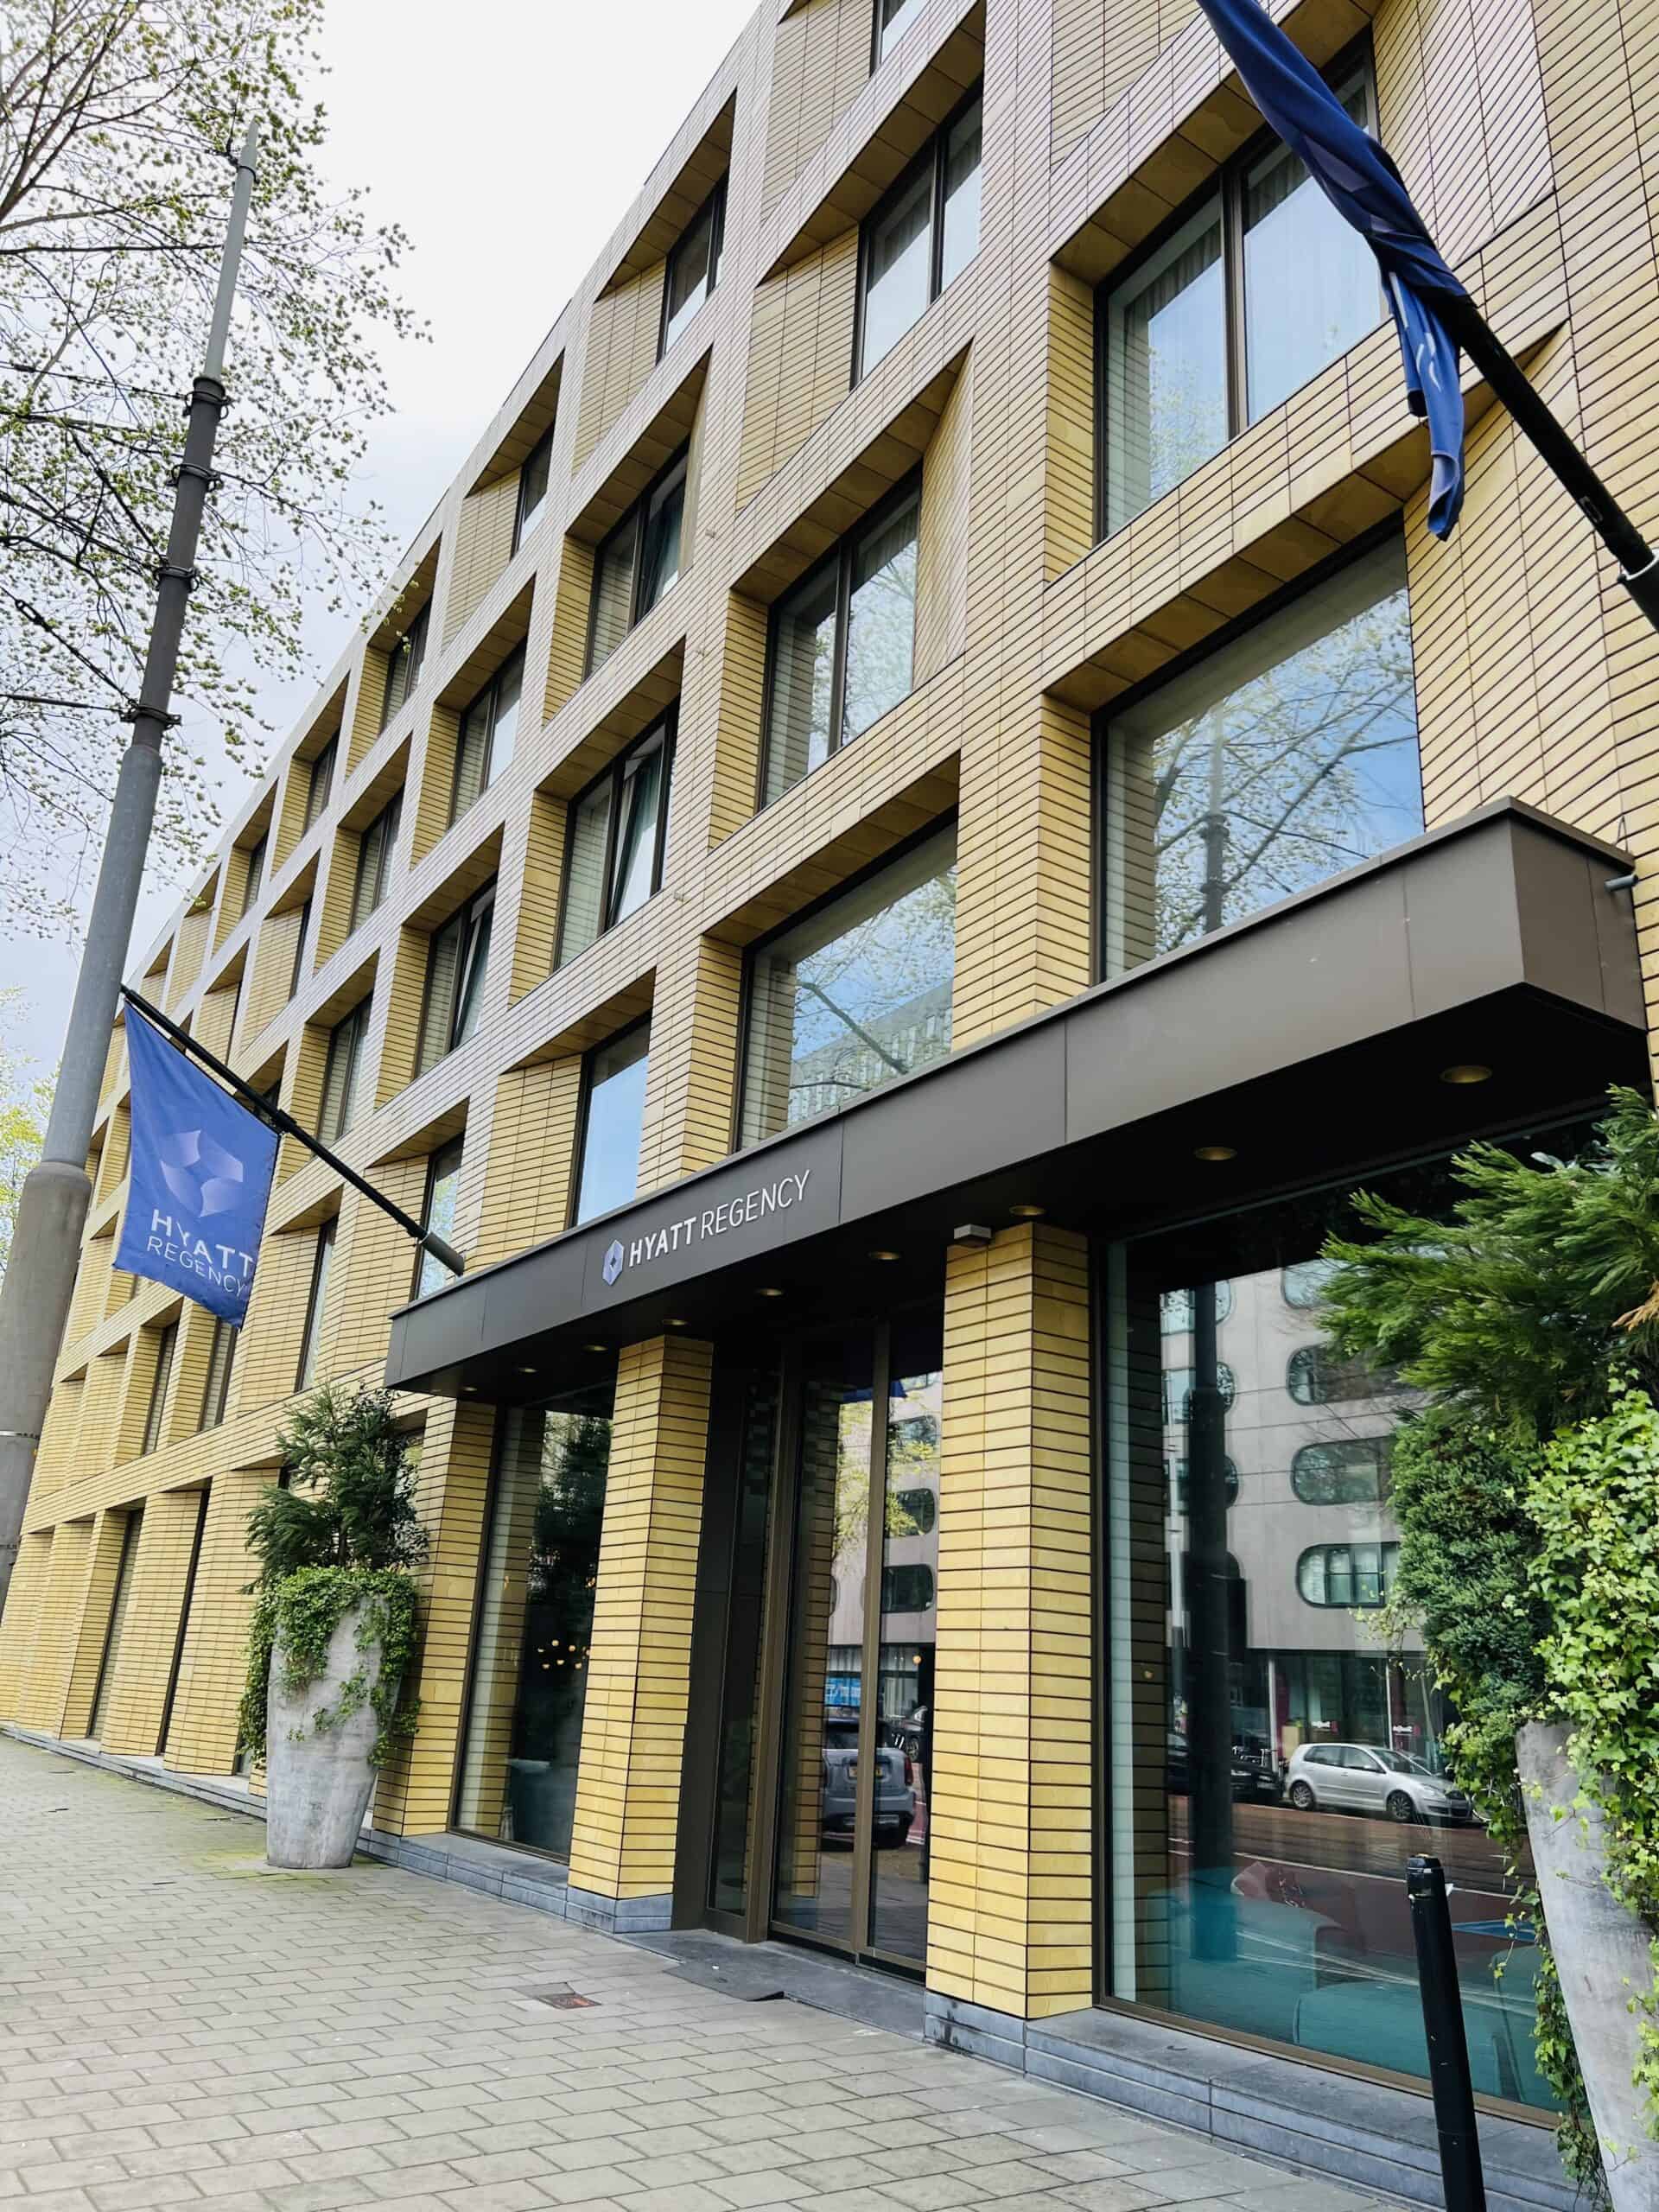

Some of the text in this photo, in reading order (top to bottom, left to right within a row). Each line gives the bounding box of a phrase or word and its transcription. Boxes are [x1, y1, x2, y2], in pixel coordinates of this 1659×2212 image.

[150, 1209, 253, 1277] HYATT
[629, 1169, 810, 1268] HYATT REGENCY
[148, 1236, 245, 1297] REGENCY
